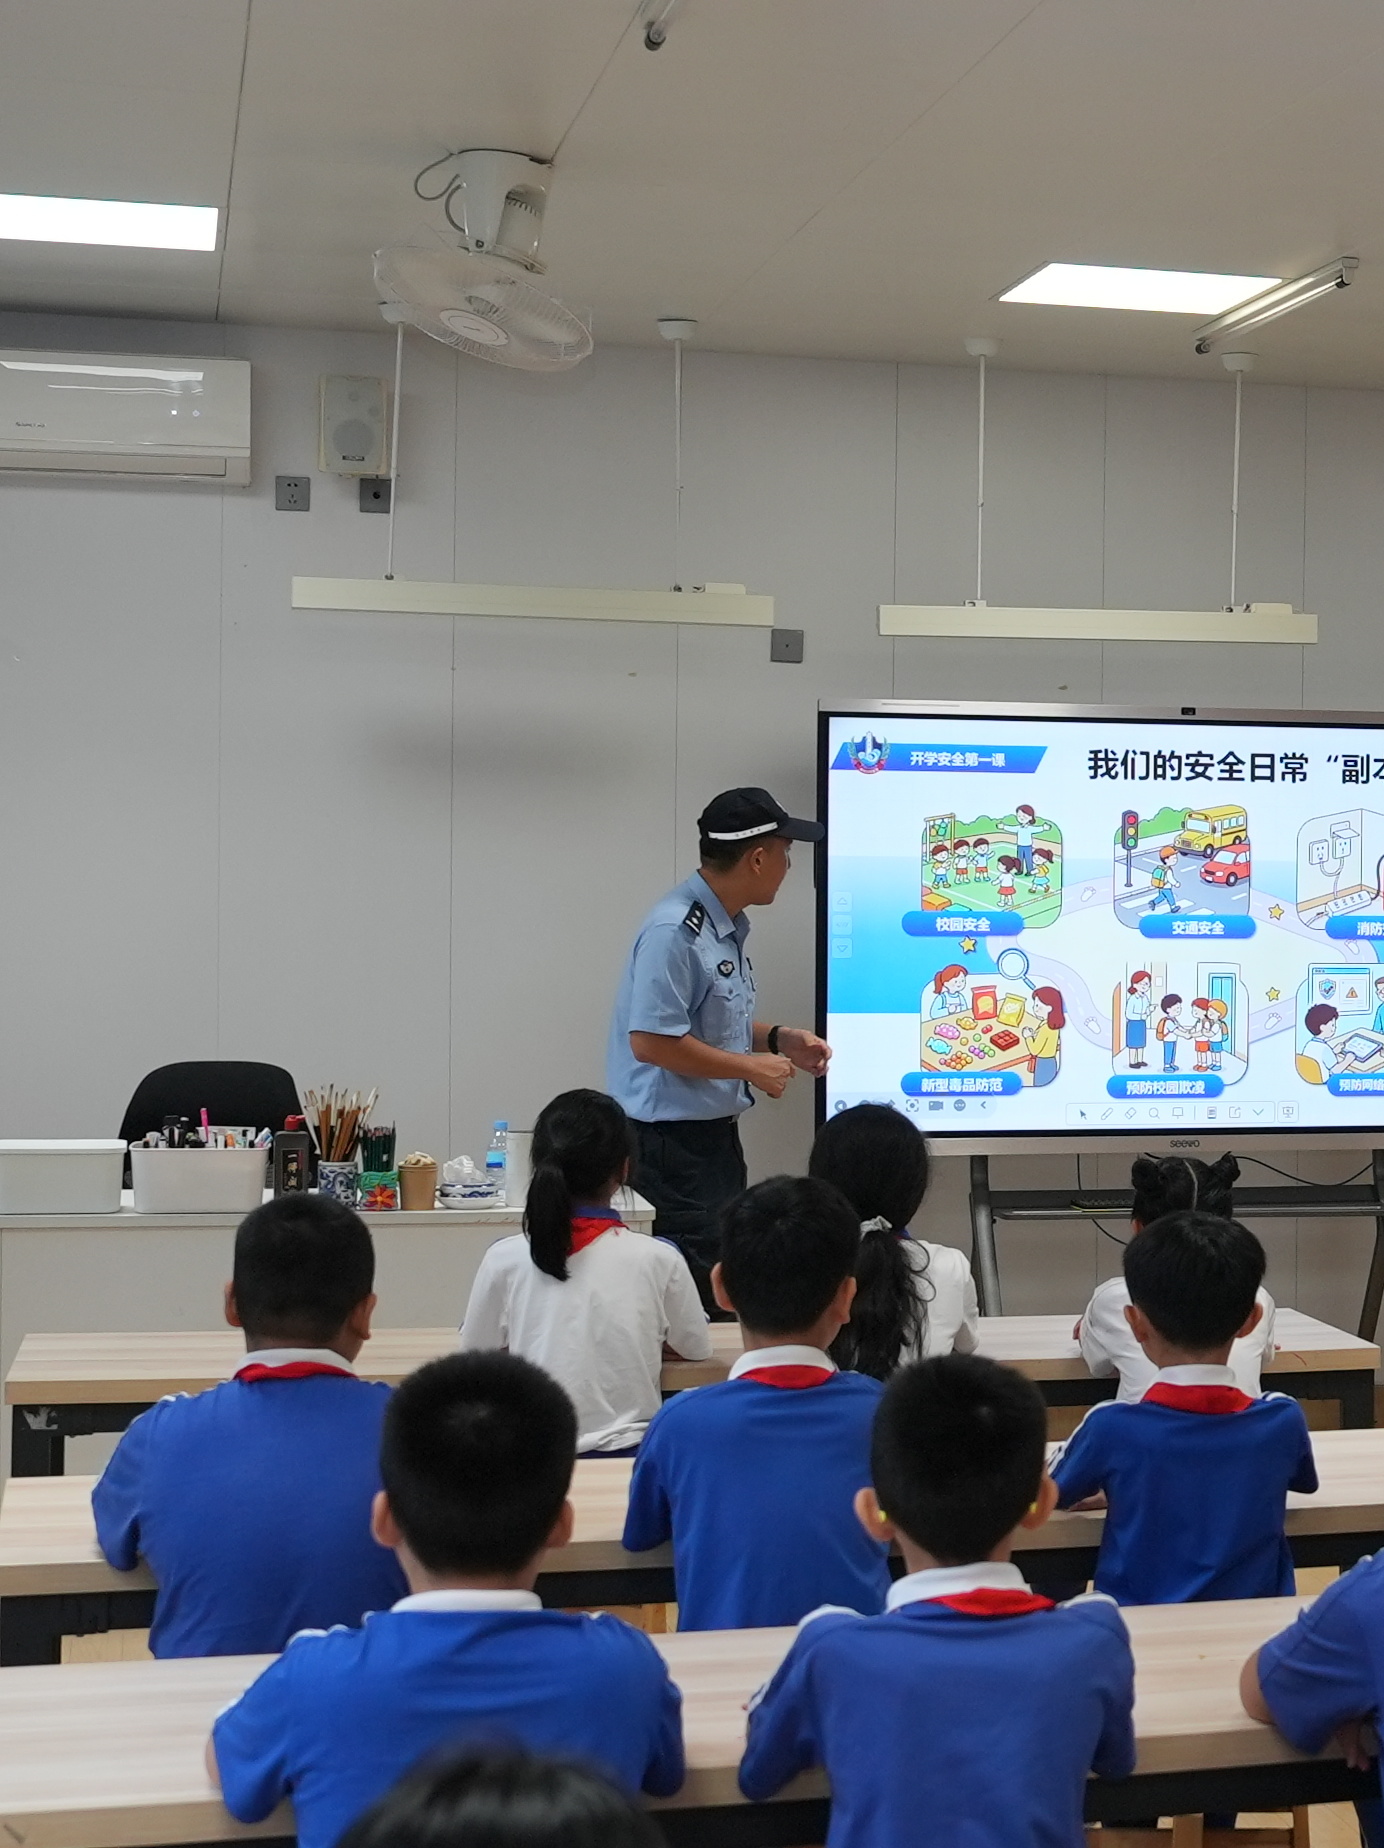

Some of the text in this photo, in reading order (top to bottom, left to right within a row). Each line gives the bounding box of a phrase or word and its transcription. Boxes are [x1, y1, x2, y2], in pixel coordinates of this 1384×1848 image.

[910, 751, 1005, 767] 开学安全第一课
[935, 917, 991, 932] 校园安全
[1171, 920, 1225, 935] 交通安全
[921, 1078, 1003, 1093] 新型毒品防范
[1126, 1080, 1206, 1095] 预防校园欺凌
